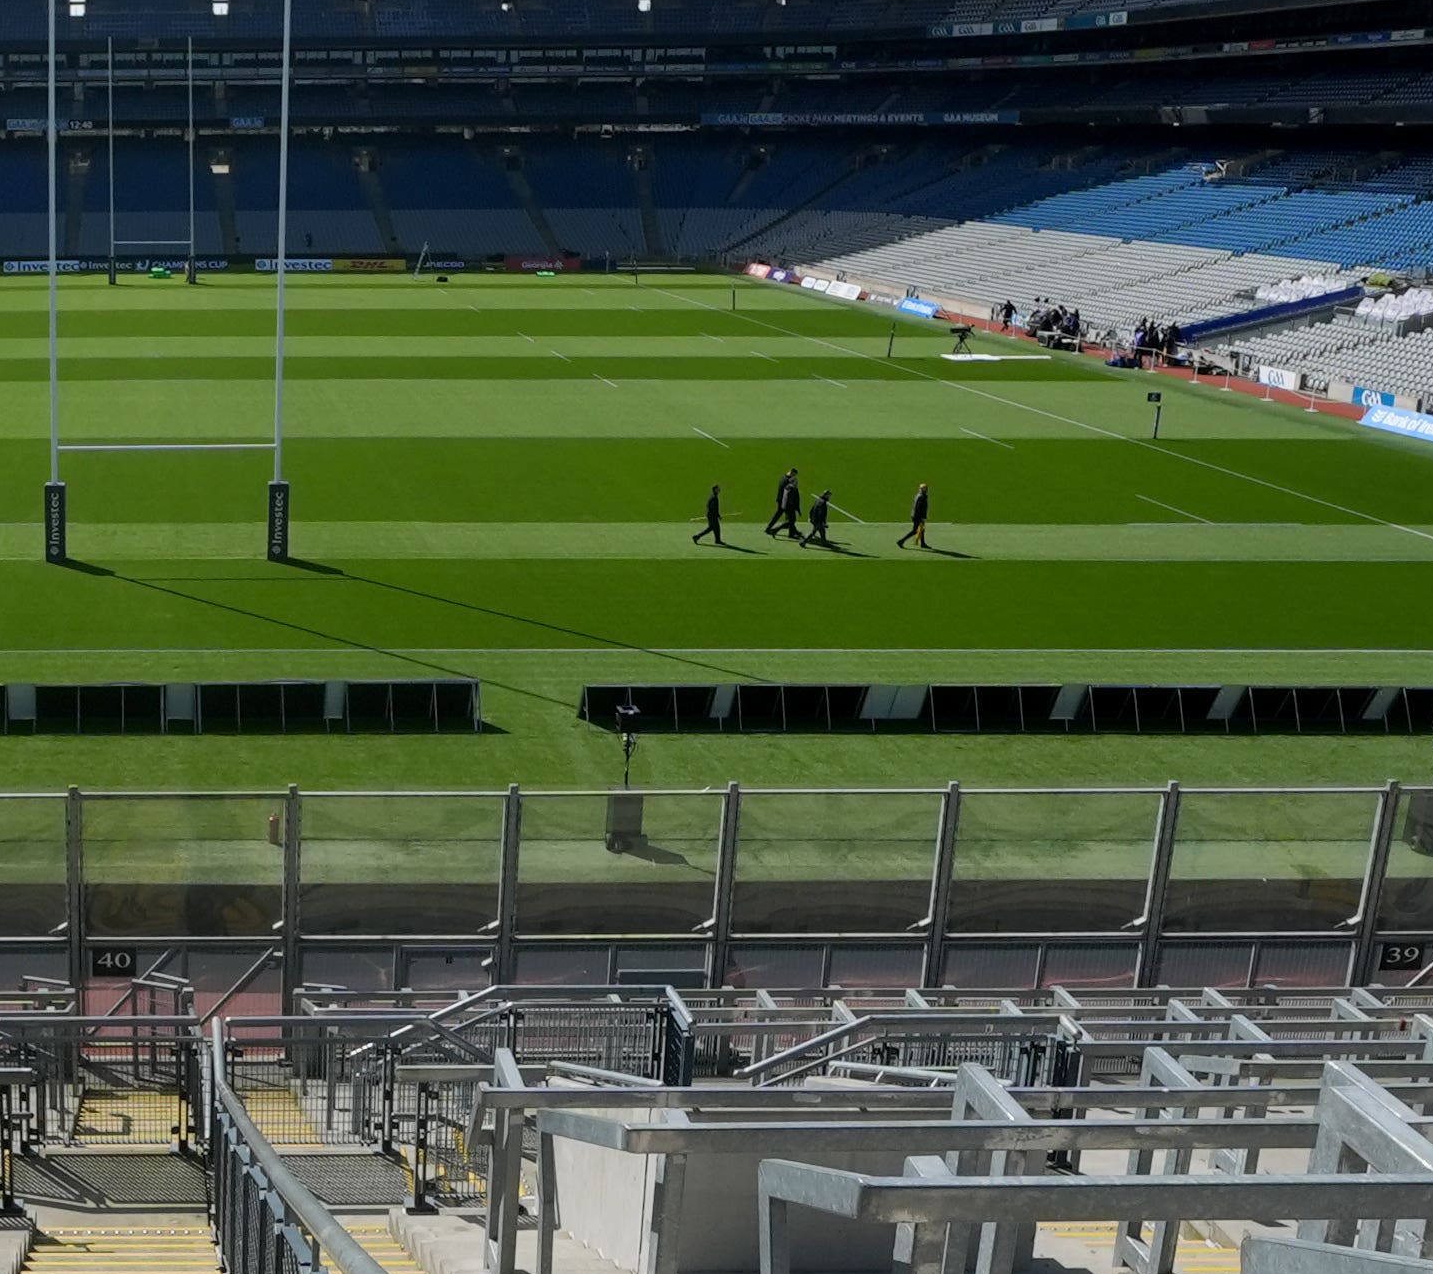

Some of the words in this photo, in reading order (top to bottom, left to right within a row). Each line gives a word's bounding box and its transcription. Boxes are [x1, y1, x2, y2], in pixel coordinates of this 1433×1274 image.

[18, 261, 79, 272] Invetec
[89, 260, 132, 270] Invetec
[1383, 412, 1407, 428] Bank
[49, 492, 61, 545] Investec
[272, 491, 284, 544] Investec
[96, 951, 131, 969] 40
[1385, 946, 1420, 964] 39
